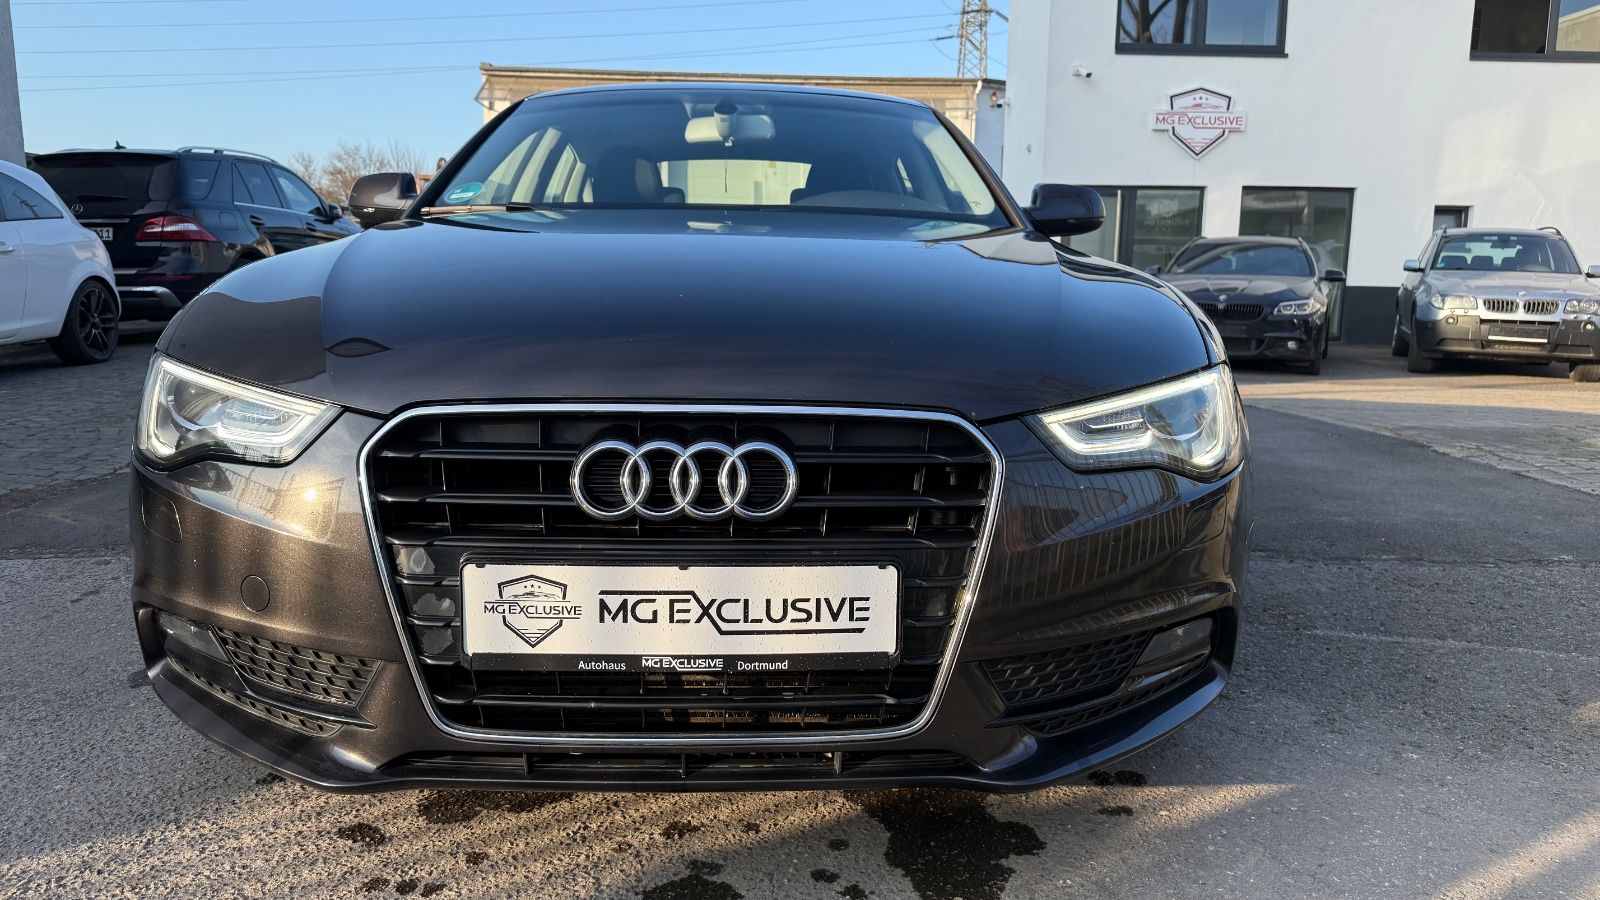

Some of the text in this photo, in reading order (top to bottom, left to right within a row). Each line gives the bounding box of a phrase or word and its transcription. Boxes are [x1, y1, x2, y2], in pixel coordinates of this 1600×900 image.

[1155, 115, 1243, 126] MG EXCLUSIVE
[483, 604, 582, 616] MG EXCLUSIVE
[598, 596, 871, 625] MG EXCLUSIVE
[578, 658, 788, 671] Autohaus MG EXCLUSIVE Dortmund
